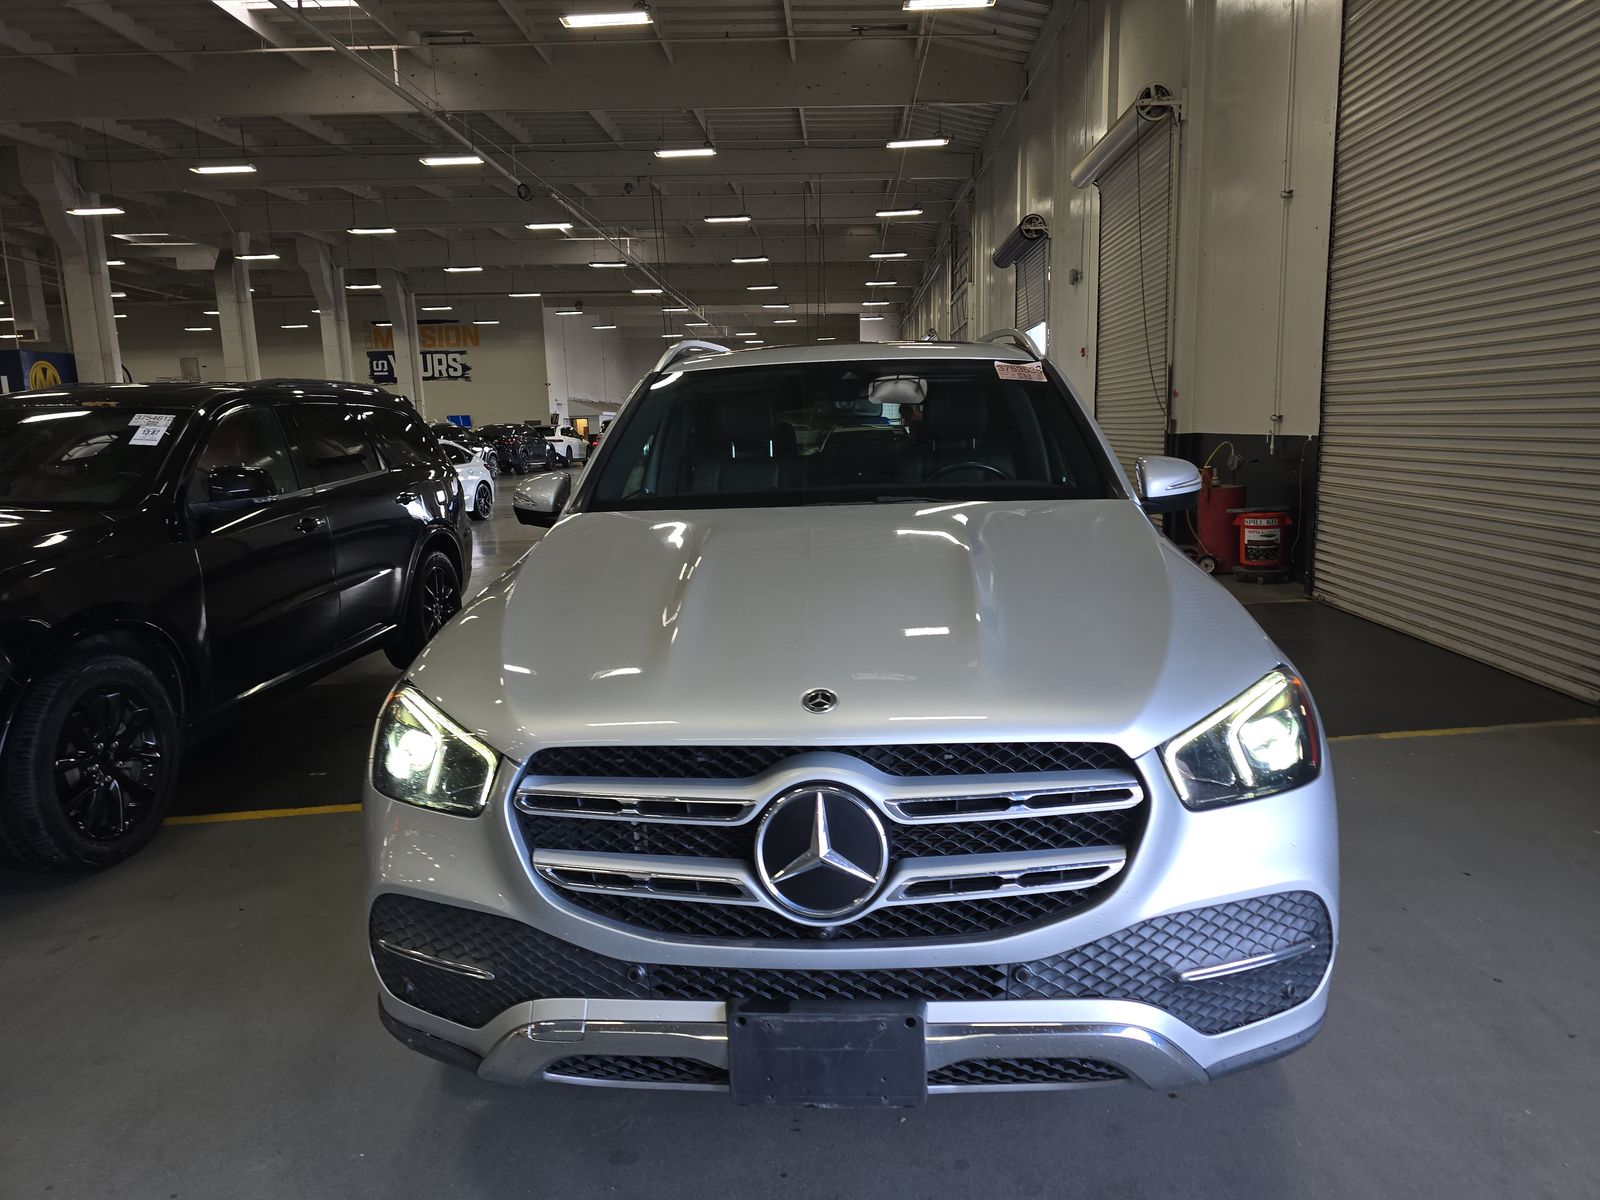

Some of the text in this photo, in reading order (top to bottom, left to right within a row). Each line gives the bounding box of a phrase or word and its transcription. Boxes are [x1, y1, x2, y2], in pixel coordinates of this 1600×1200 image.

[373, 325, 480, 349] MSION
[373, 360, 389, 375] IS
[388, 353, 463, 378] YURS
